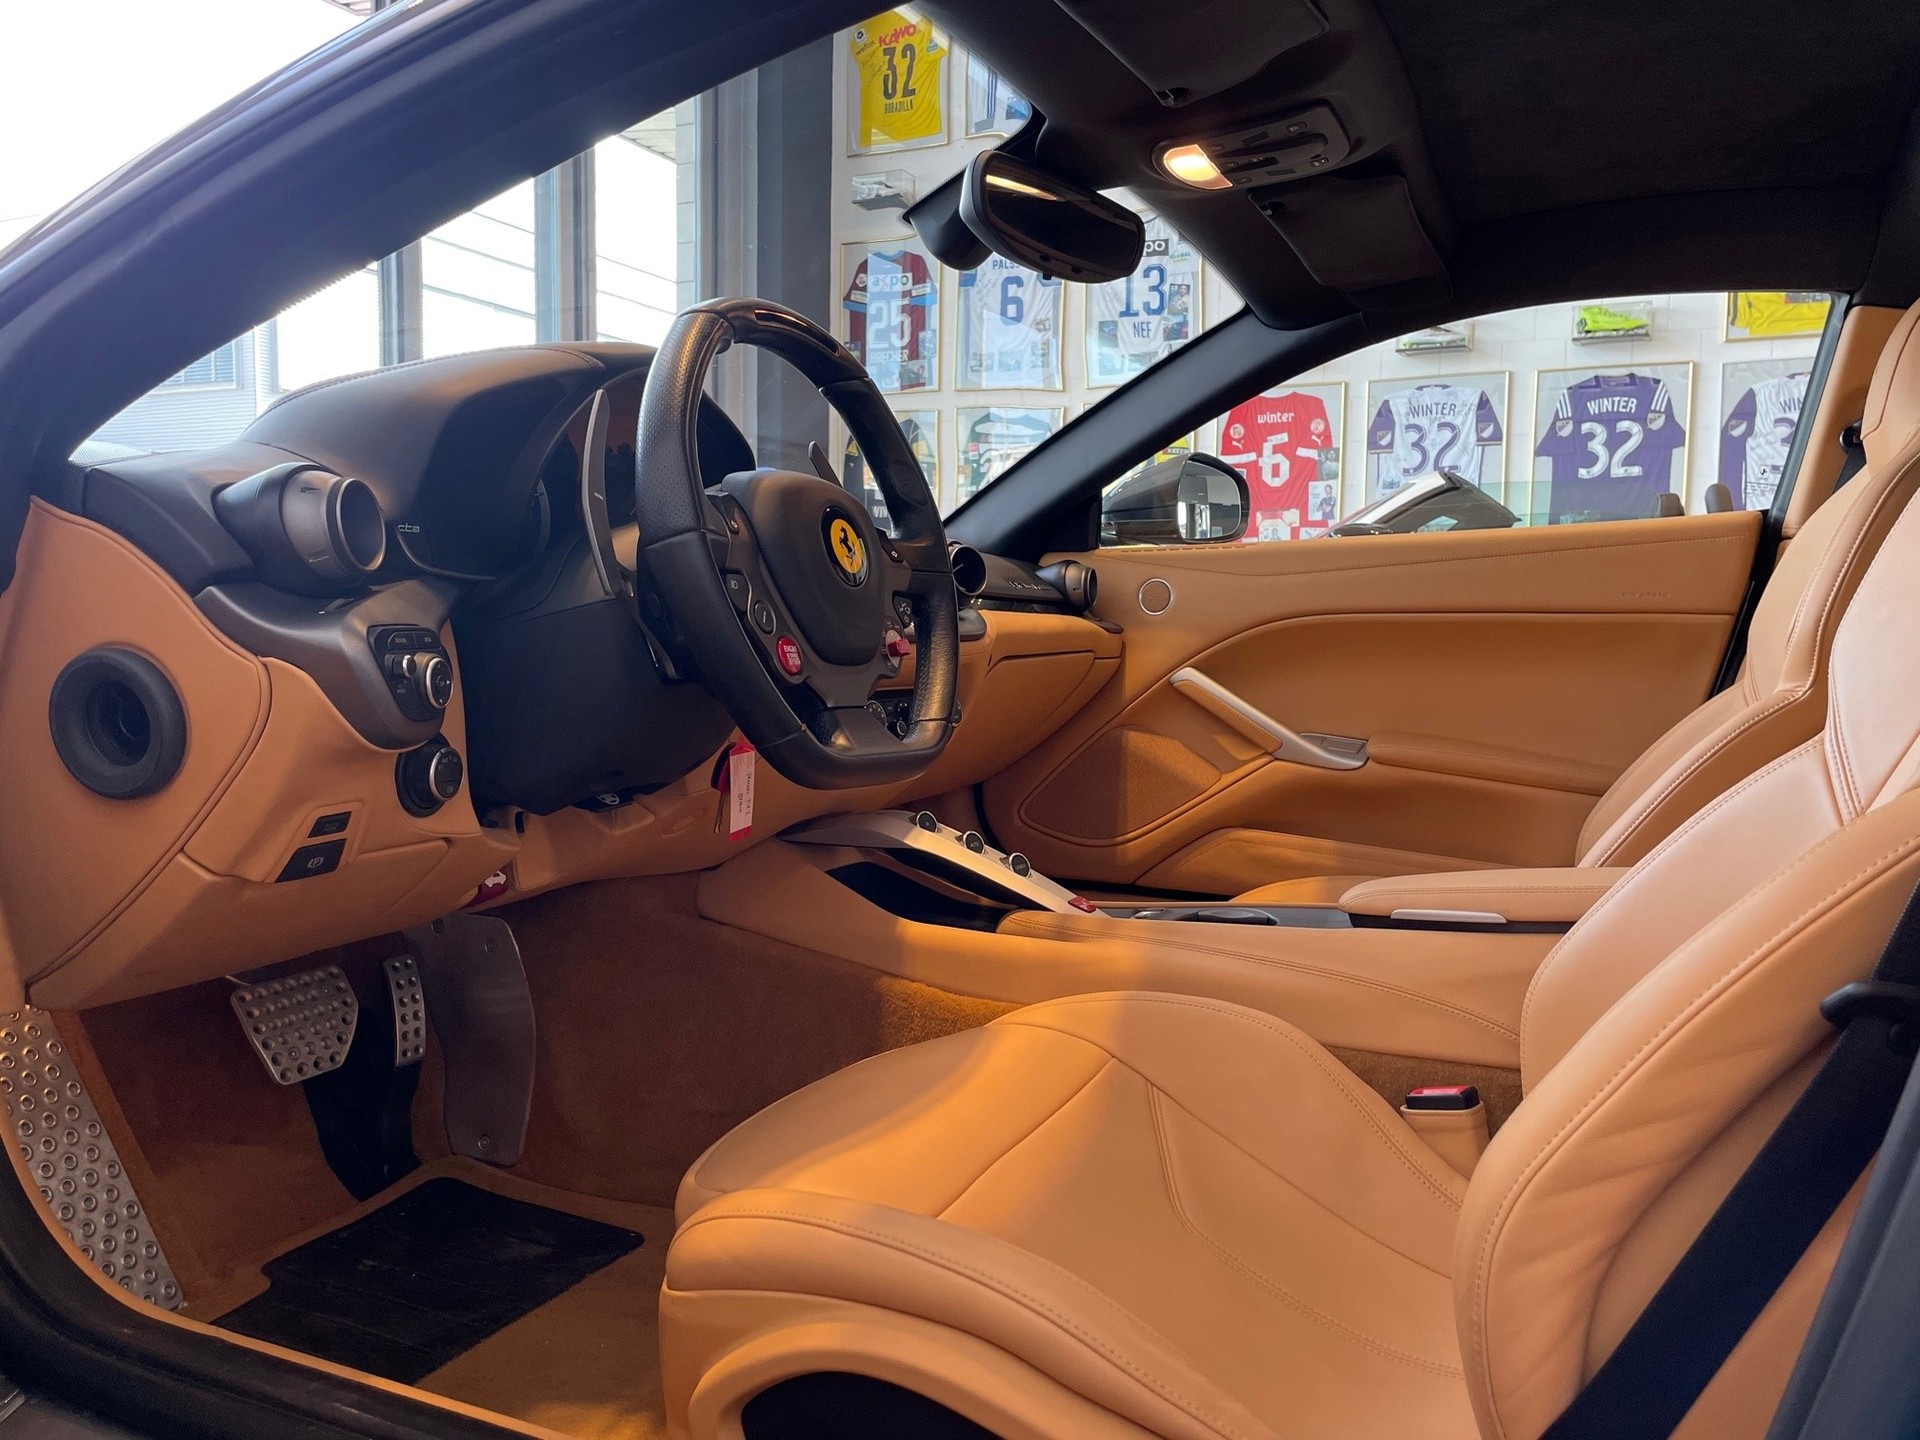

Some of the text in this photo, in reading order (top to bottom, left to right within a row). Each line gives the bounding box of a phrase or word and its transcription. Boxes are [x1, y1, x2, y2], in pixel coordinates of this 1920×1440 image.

[883, 44, 916, 100] 32
[1000, 275, 1024, 326] 6
[1119, 263, 1168, 318] 13
[868, 301, 912, 349] 25
[1133, 321, 1152, 338] NEF
[1257, 411, 1295, 424] winter
[1409, 402, 1457, 418] WINTER
[1586, 396, 1637, 416] WINTER
[1258, 432, 1290, 487] 6
[1402, 421, 1461, 476] 32
[1577, 419, 1644, 479] 32
